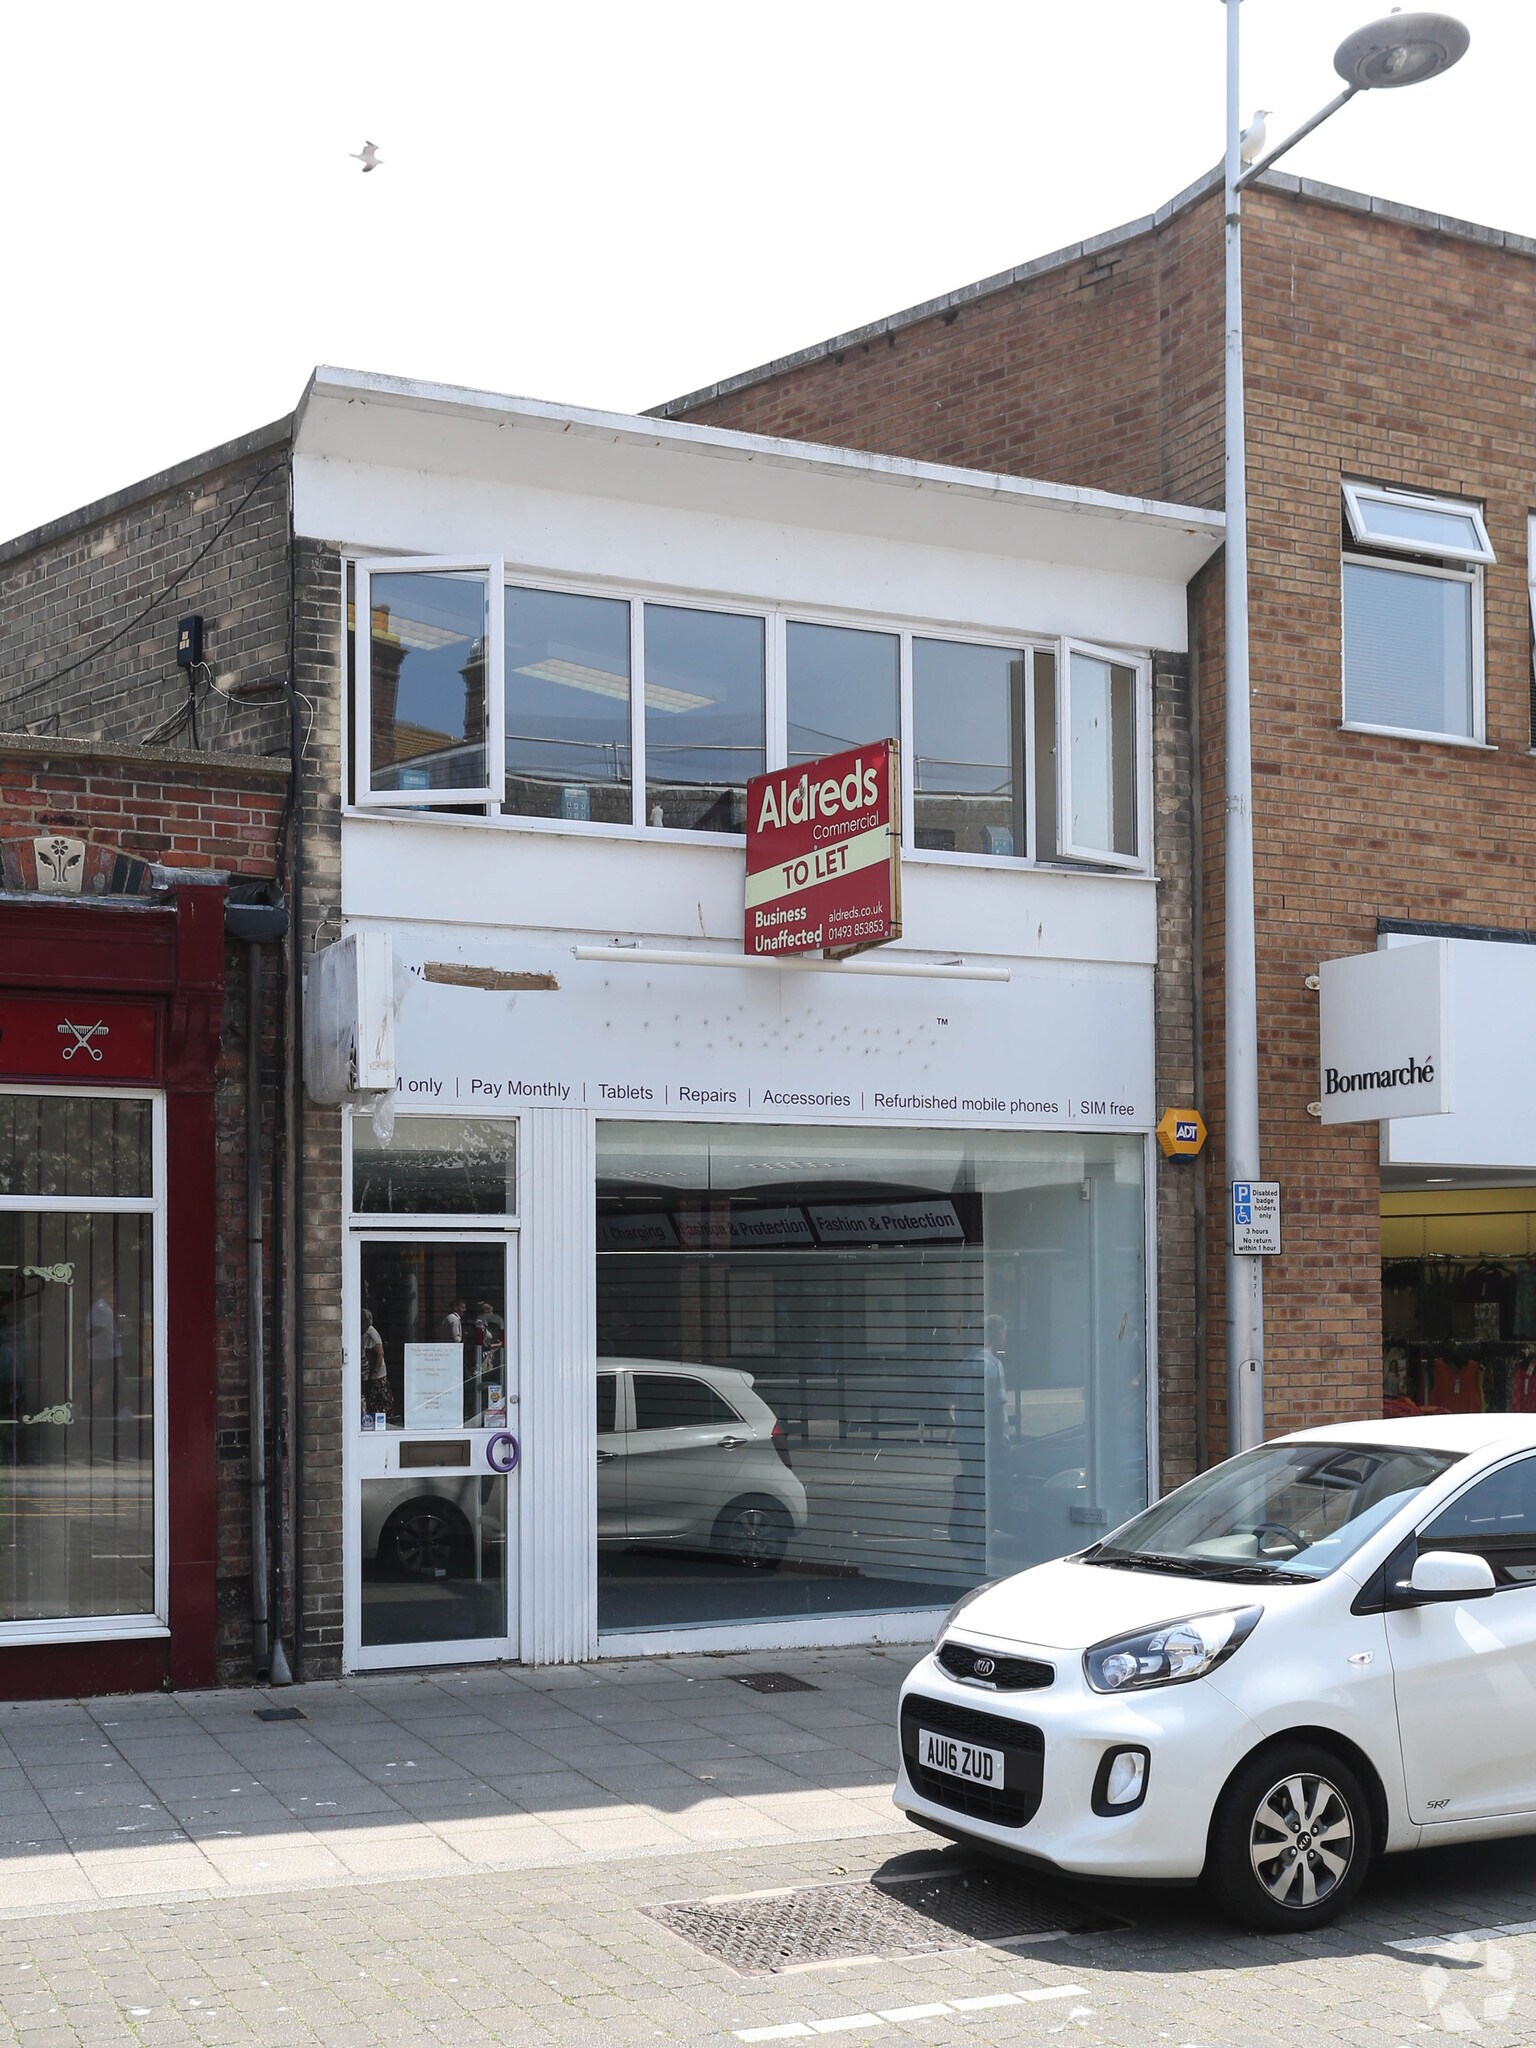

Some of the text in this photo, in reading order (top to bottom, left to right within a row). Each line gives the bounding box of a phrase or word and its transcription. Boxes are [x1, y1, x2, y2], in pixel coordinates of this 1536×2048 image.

[757, 759, 878, 833] Aldreds
[813, 812, 879, 840] Commercial
[782, 845, 848, 889] TO LET
[755, 906, 807, 928] Business
[829, 901, 883, 922] aldreds.co.uk
[755, 924, 822, 952] Unaffected
[829, 920, 884, 943] 01493 853853
[1325, 1055, 1434, 1094] Bonmarché
[408, 1077, 443, 1097] only
[471, 1079, 570, 1101] Pay Monthly
[598, 1083, 653, 1100] Tablets
[679, 1087, 737, 1105] Repairs
[763, 1089, 851, 1106] Accessories
[874, 1093, 1059, 1115] Refurbished mobile phones
[1080, 1101, 1135, 1116] SIM free
[1176, 1123, 1198, 1141] ADT
[1252, 1189, 1278, 1197] Disabled
[679, 1221, 728, 1238] Fashion
[739, 1218, 810, 1236] Protection
[816, 1211, 956, 1233] Fashion & Protection
[610, 1224, 666, 1242] Charging
[976, 1659, 991, 1672] KIA
[927, 1737, 993, 1782] AU16 ZUD
[1426, 1798, 1450, 1809] SR7
[1298, 1834, 1311, 1850] KIA
